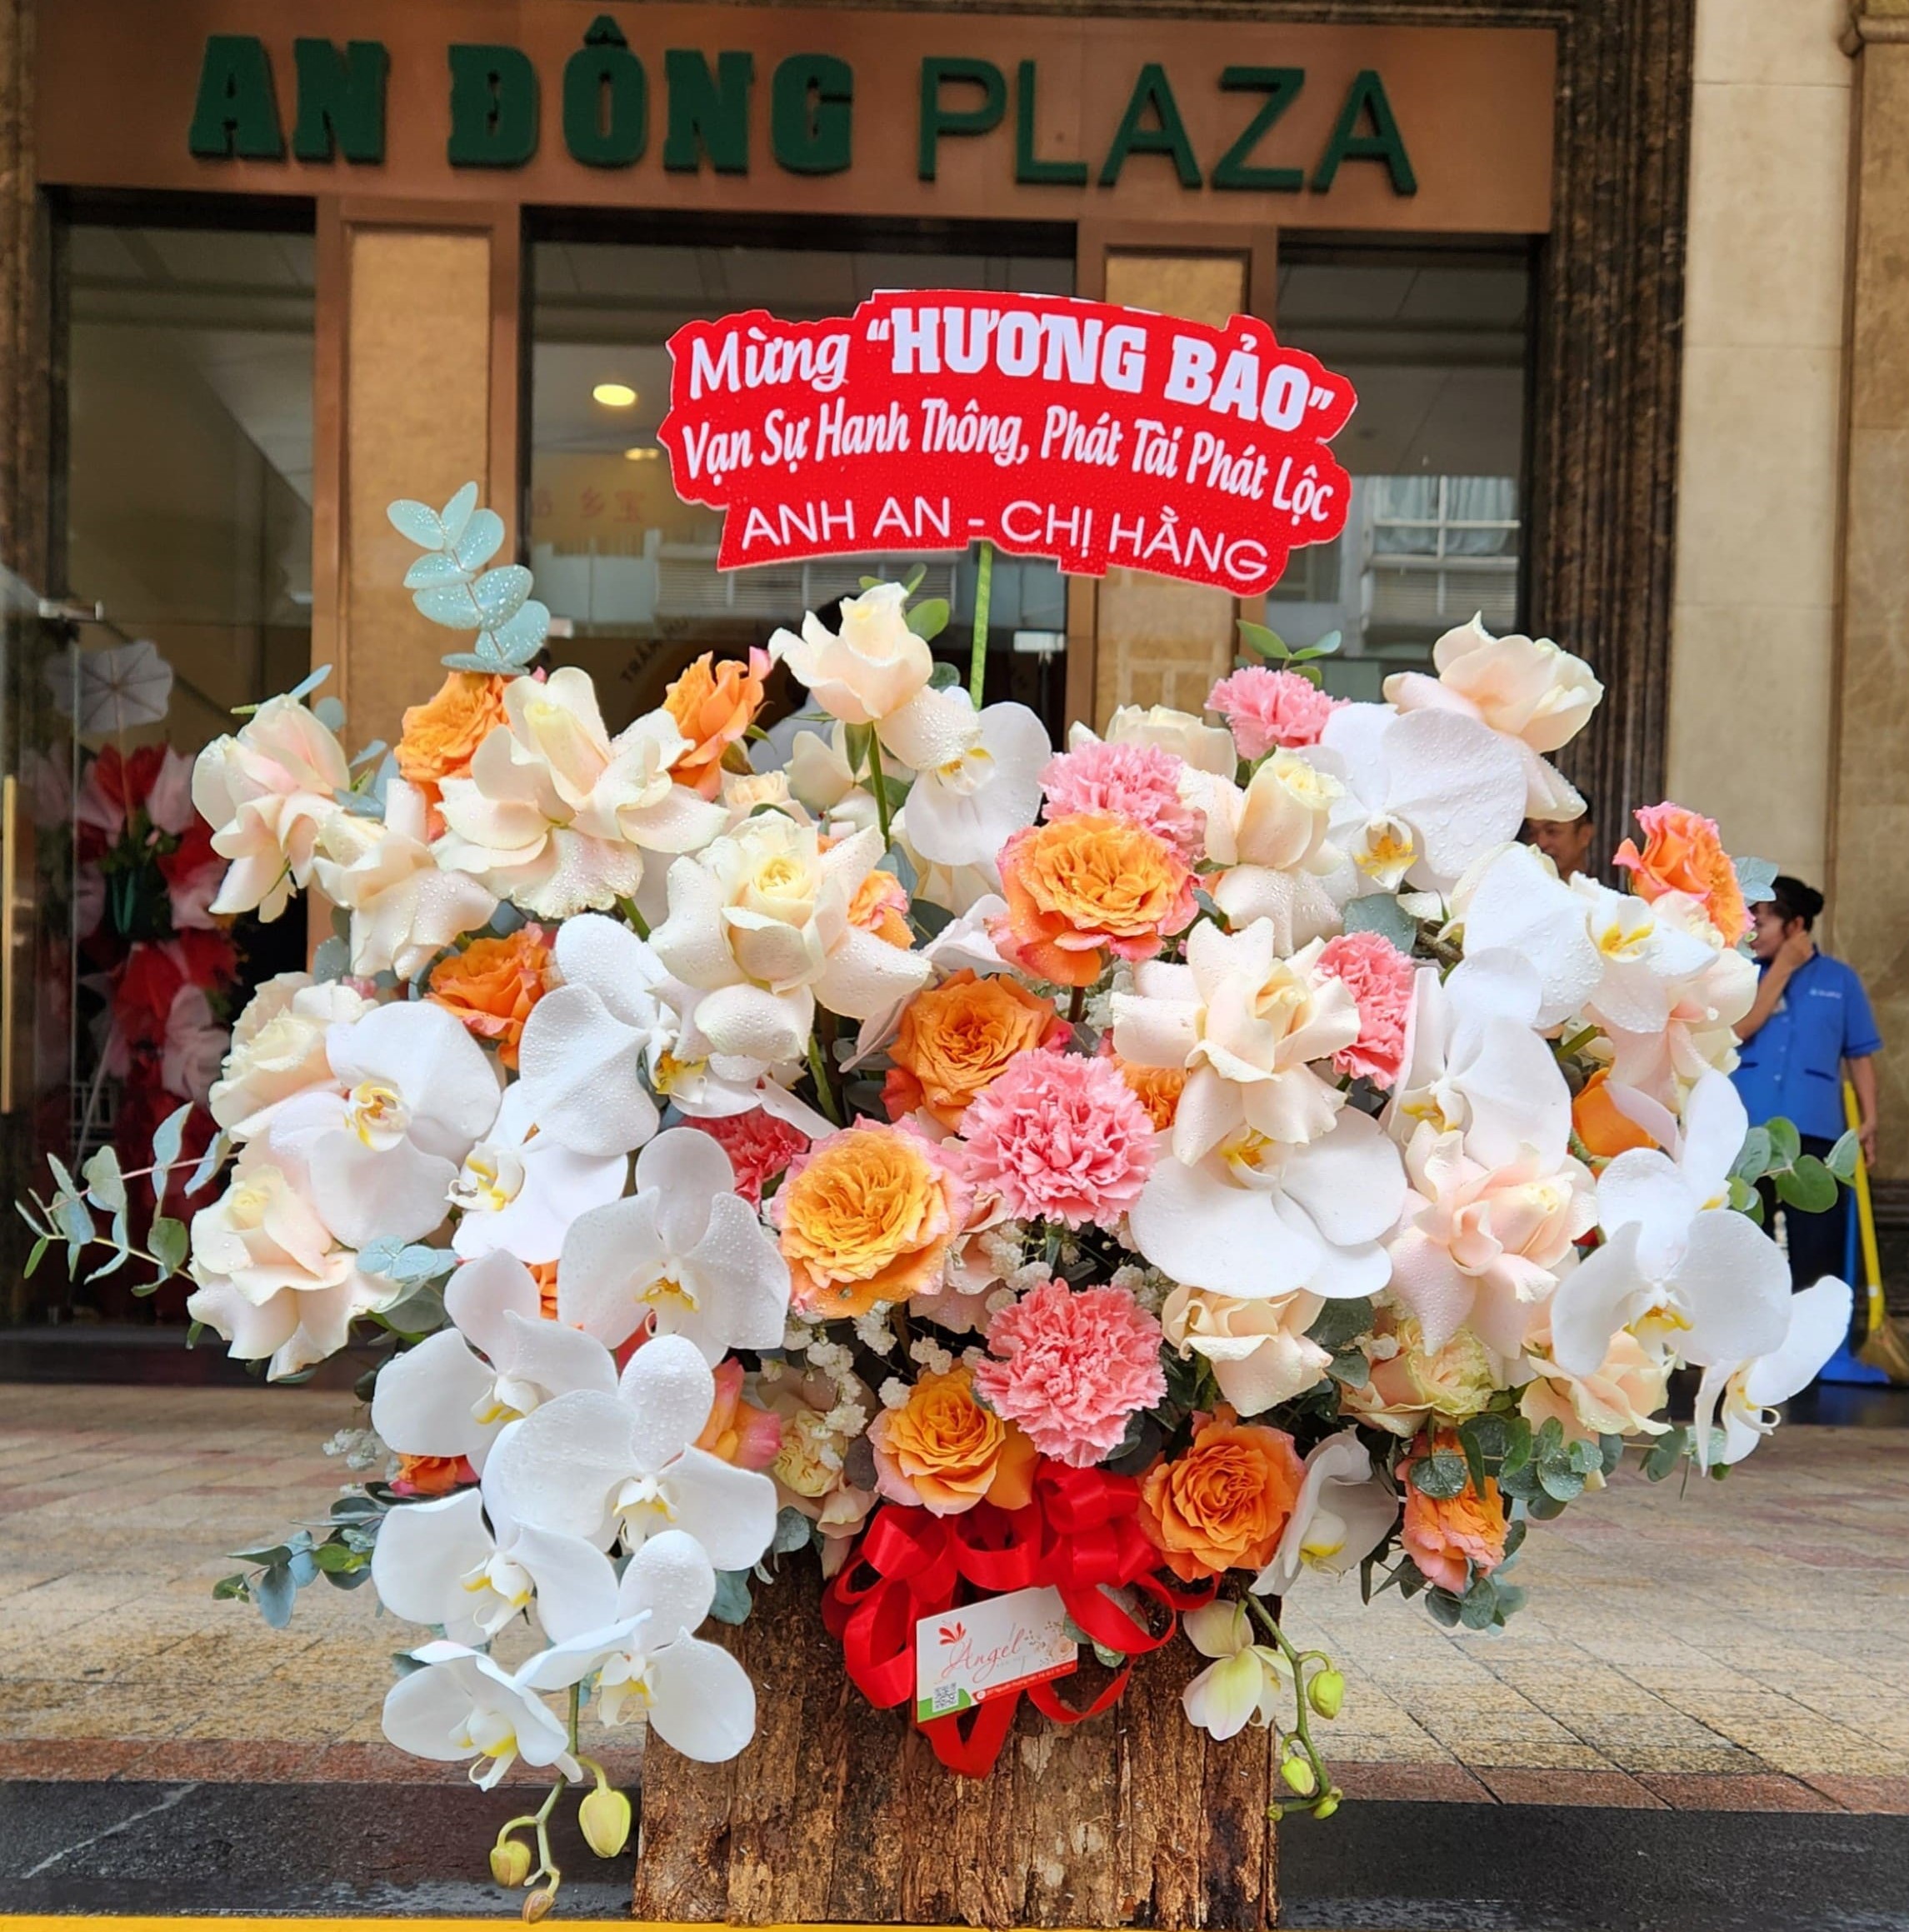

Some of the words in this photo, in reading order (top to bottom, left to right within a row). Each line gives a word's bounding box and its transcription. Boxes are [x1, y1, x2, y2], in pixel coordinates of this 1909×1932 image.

[189, 35, 390, 162] AN
[447, 14, 852, 174] ĐÔNG
[918, 57, 1417, 196] PLAZA
[690, 327, 851, 399] Mừng
[682, 422, 753, 486] Vạn
[761, 408, 810, 473] Sự
[815, 397, 910, 462] Hanh
[921, 397, 1030, 467] Thông,
[1040, 405, 1123, 467] Phát
[1131, 417, 1183, 478] Tài
[1186, 431, 1268, 500] Phát
[1272, 456, 1334, 526] Lộc
[742, 498, 855, 550] ANH
[872, 497, 951, 537] AN
[1001, 500, 1092, 557] CHỊ
[1108, 505, 1268, 581] HẰNG
[941, 1628, 1025, 1684] Angel
